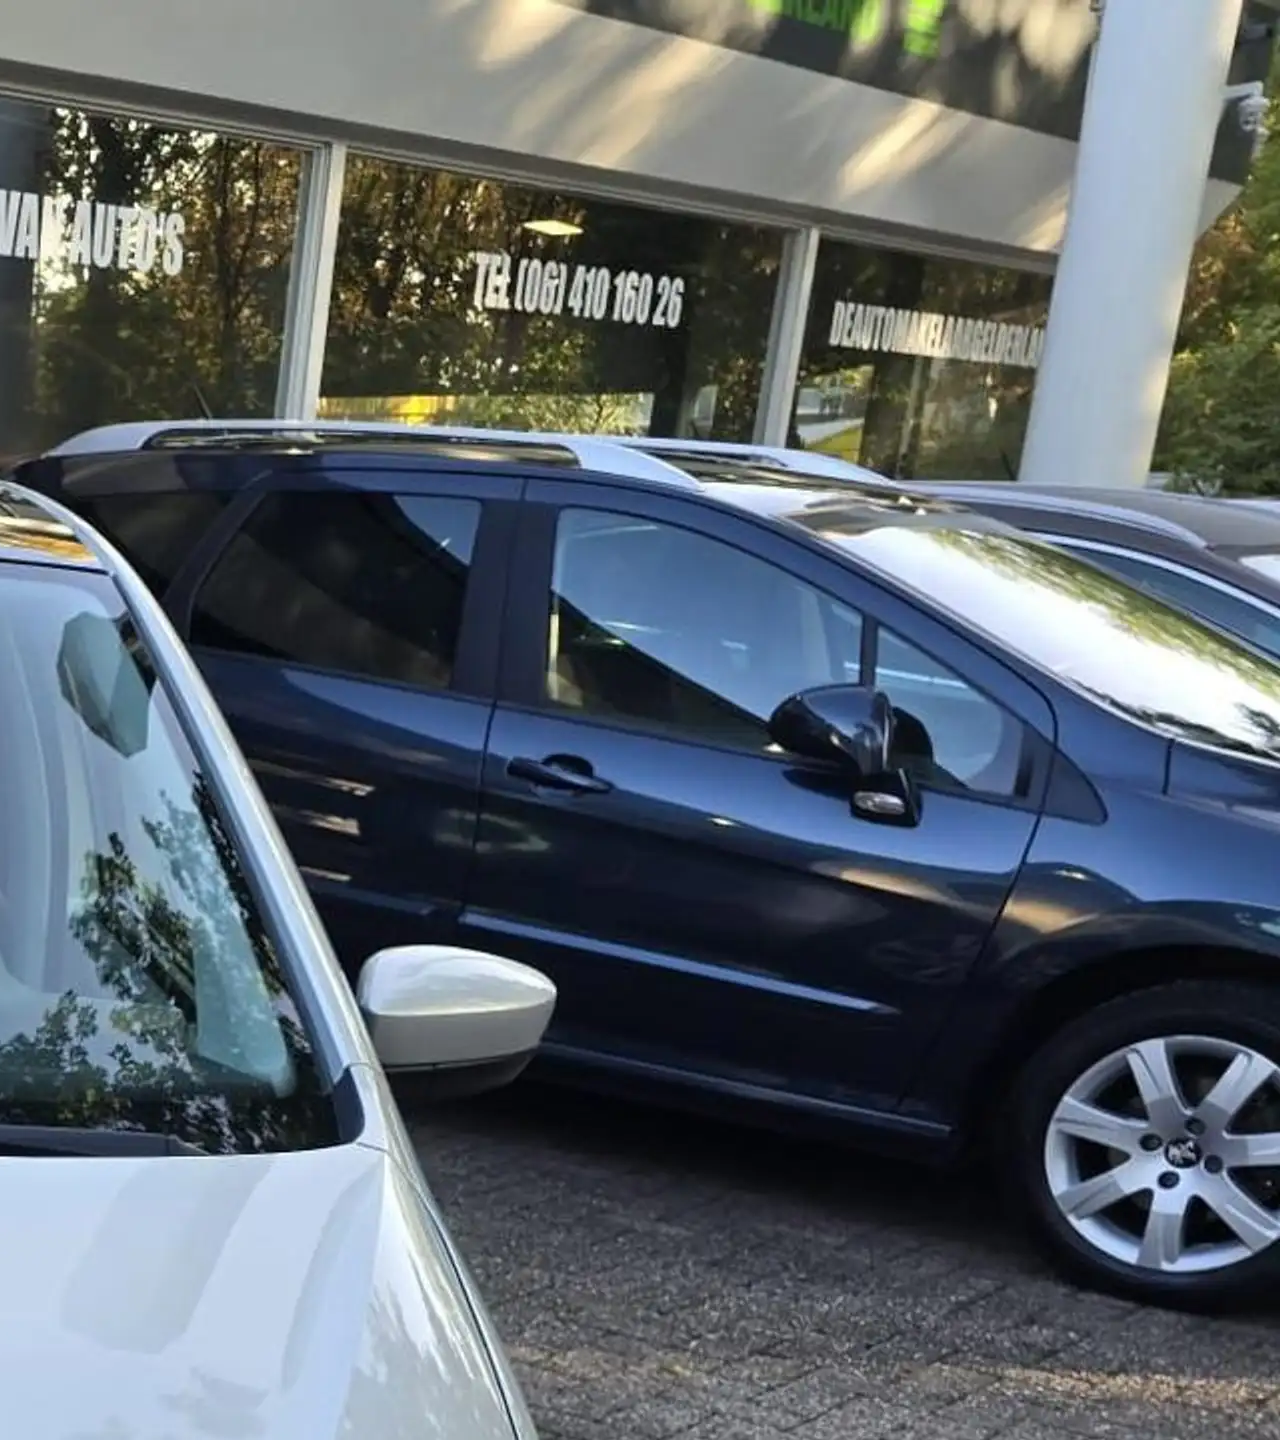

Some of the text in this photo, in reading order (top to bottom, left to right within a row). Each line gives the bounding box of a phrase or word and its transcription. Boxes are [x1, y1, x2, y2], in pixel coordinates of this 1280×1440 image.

[72, 199, 185, 277] AUTO'S
[514, 257, 568, 315] (06)
[568, 264, 611, 320] 410
[612, 270, 653, 325] 160
[652, 276, 685, 329] 26
